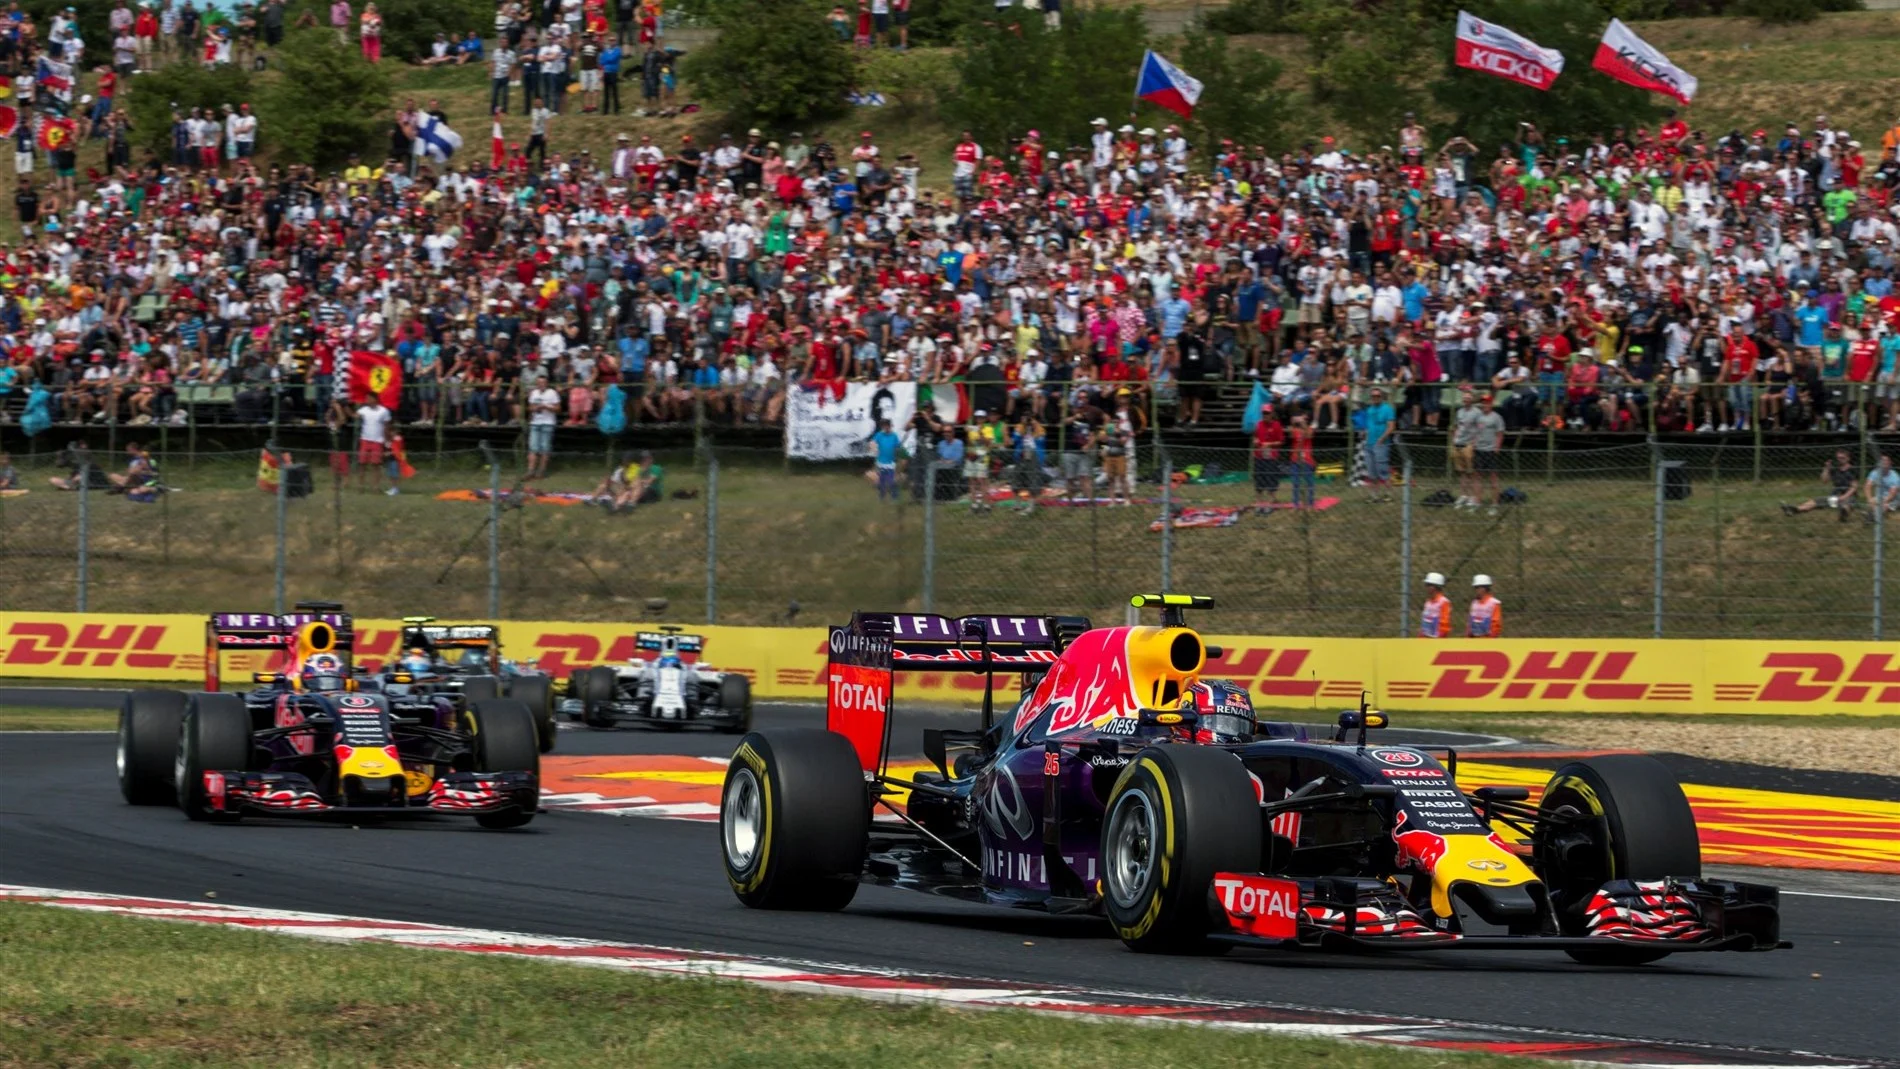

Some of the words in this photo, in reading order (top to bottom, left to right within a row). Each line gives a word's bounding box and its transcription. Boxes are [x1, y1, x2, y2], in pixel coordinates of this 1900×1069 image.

[215, 613, 342, 628] NFINII
[893, 615, 1048, 637] NFIITI
[3, 622, 176, 668] DHL
[1198, 648, 1323, 697] HL
[1428, 651, 1650, 700] DHL
[1756, 652, 1900, 703] DH
[830, 674, 886, 712] TOTAL
[1094, 717, 1138, 735] ness
[1044, 751, 1059, 776] 26
[1380, 752, 1417, 762] 26
[1382, 768, 1444, 777] TOTAL
[1401, 789, 1457, 797] PIRELLI
[1410, 800, 1465, 808] CASIO
[1418, 810, 1474, 818] Hisense
[984, 846, 1095, 884] INFINII
[1215, 879, 1296, 920] TOTAL
